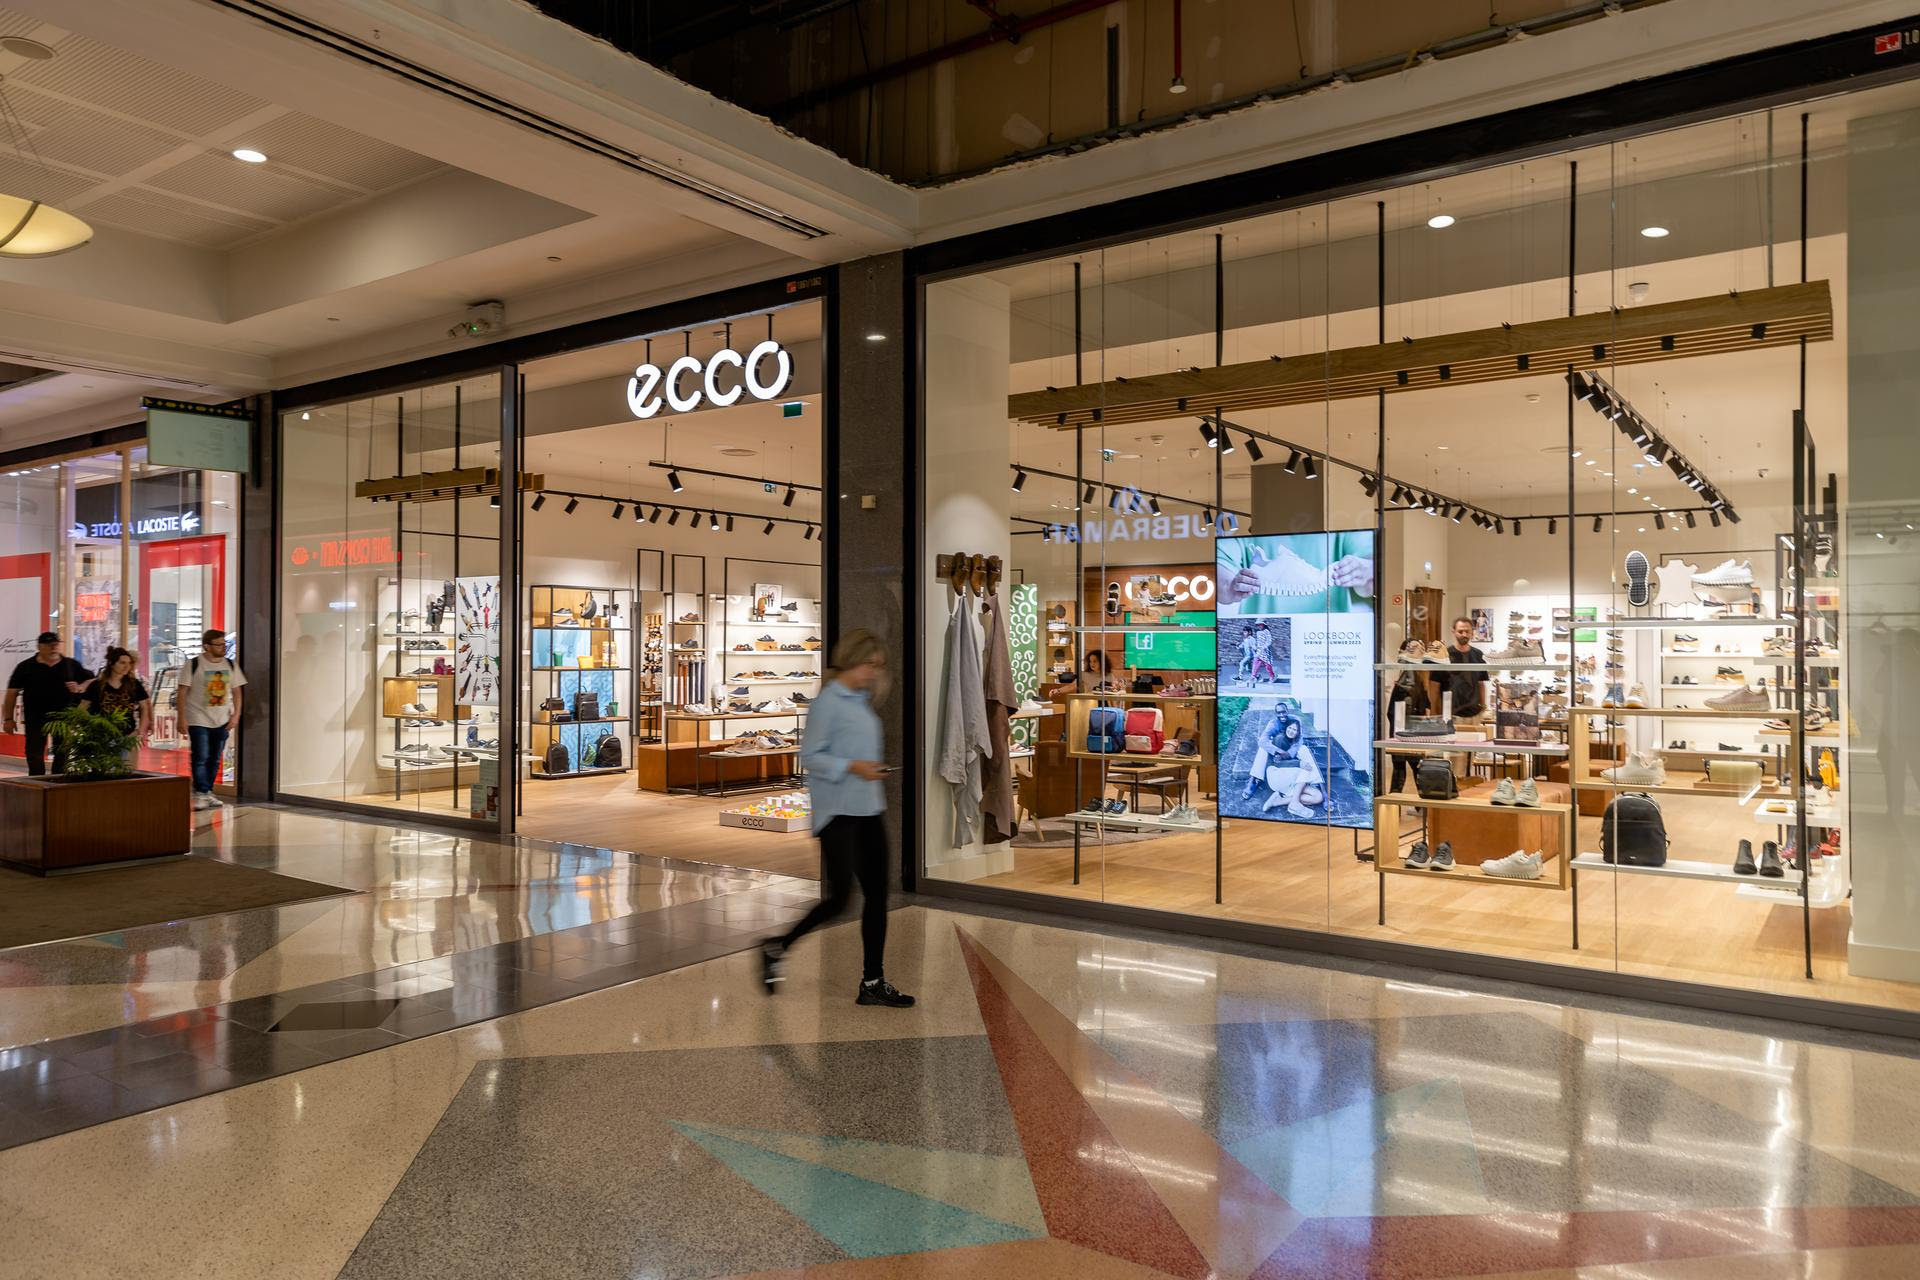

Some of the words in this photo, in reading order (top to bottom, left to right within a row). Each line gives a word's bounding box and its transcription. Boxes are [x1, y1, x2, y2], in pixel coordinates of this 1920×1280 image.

[627, 341, 793, 418] ecco
[138, 516, 179, 534] LACOSTE
[1125, 575, 1215, 601] co
[742, 817, 764, 827] ecco
